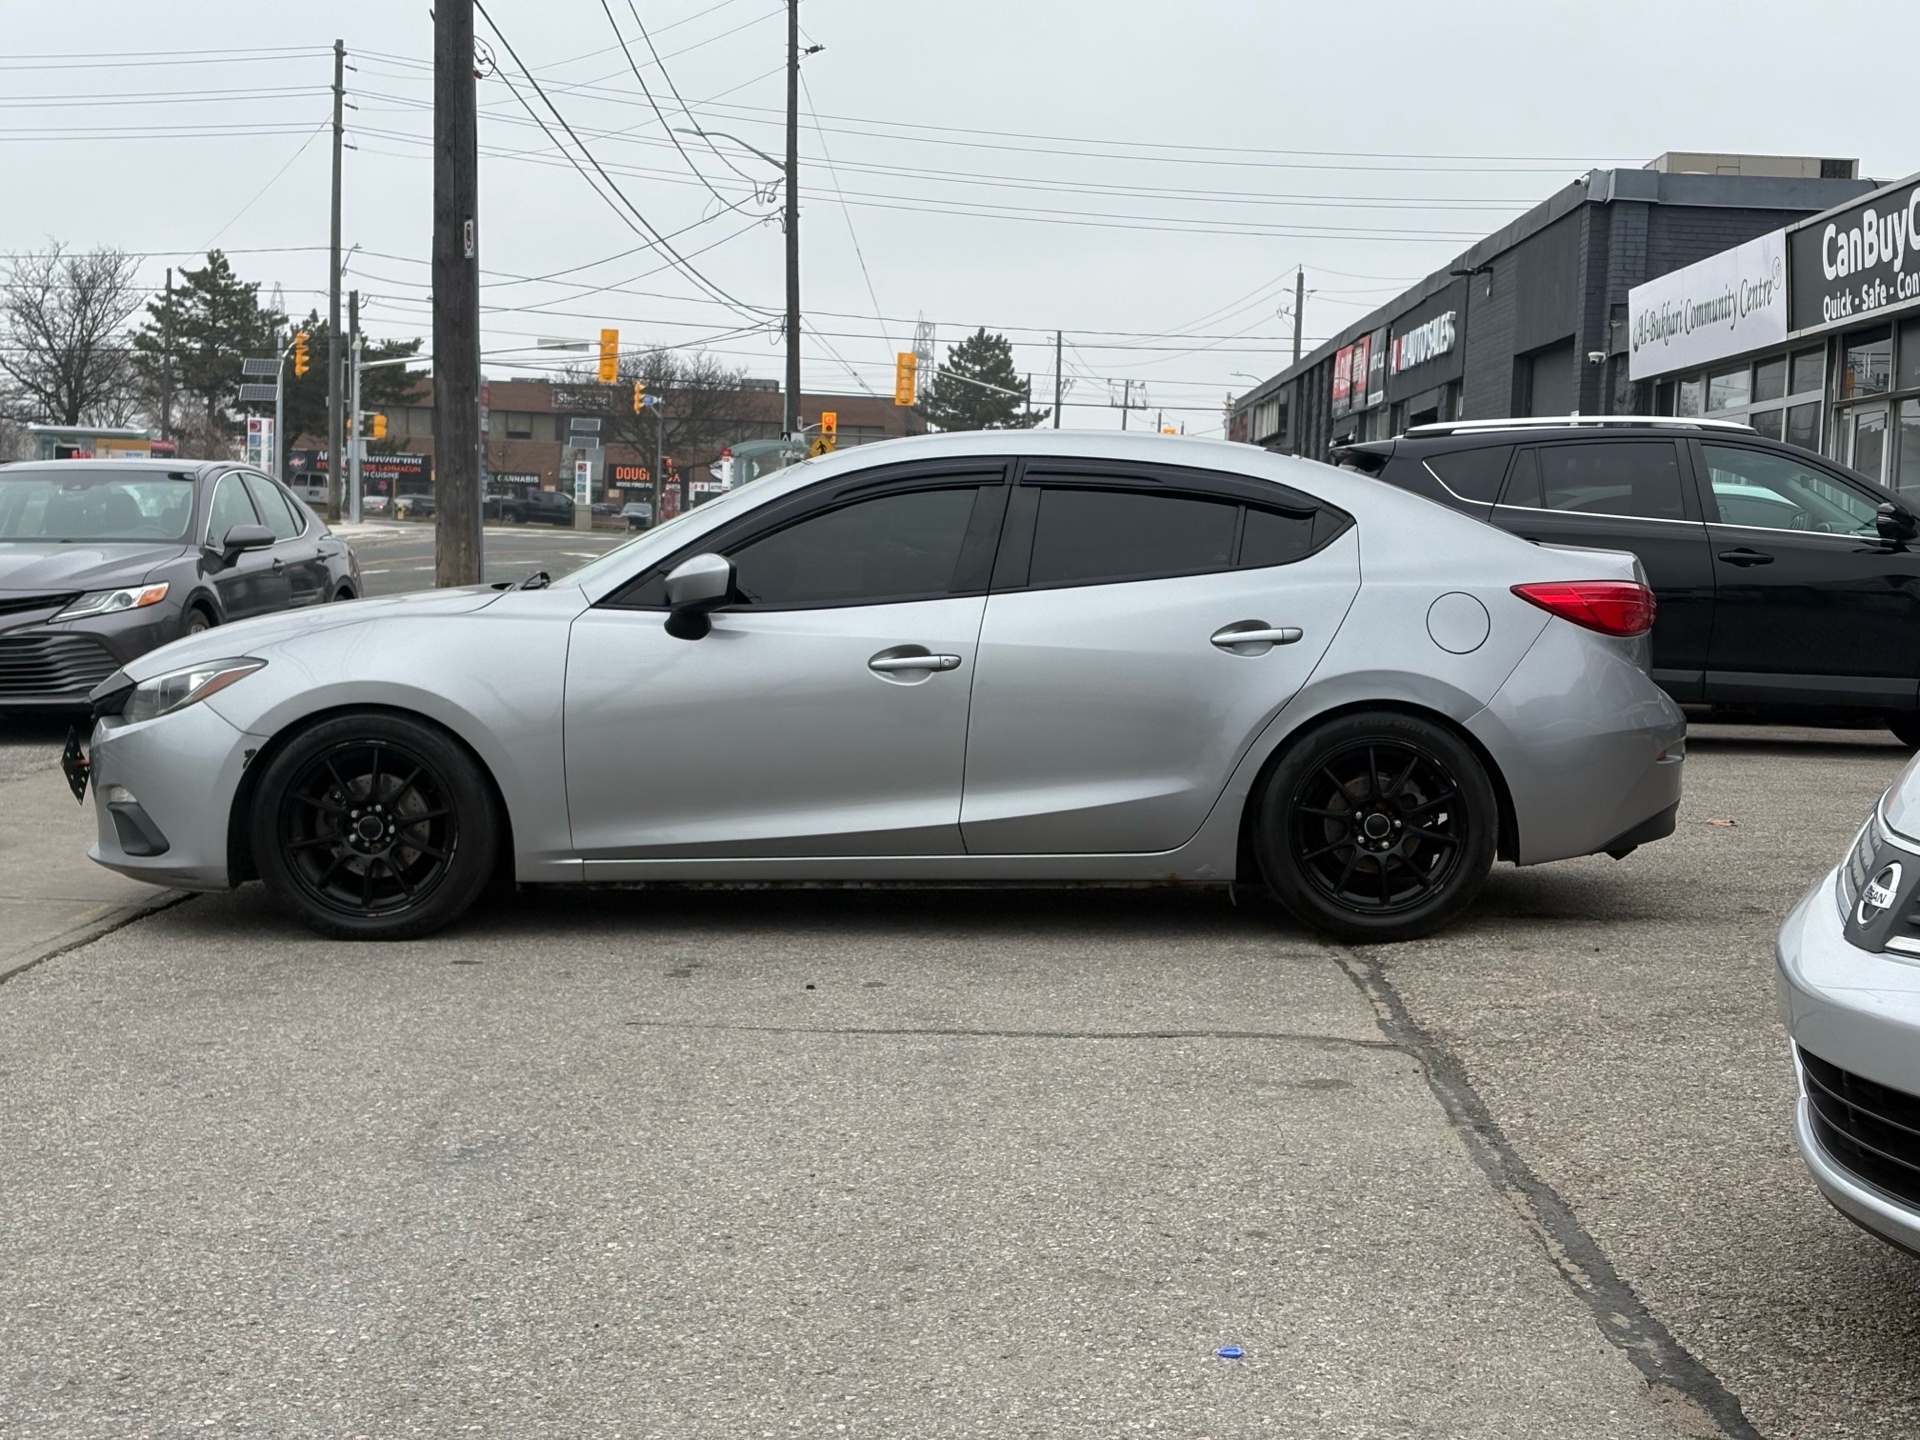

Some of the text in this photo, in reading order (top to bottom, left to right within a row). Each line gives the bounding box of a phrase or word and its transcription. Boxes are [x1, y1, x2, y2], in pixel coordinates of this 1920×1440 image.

[1633, 278, 1773, 353] Al-Bukhari Community Centre
[1823, 288, 1853, 323] Quick
[1862, 278, 1887, 311] Safe
[1897, 271, 1920, 300] Con
[1427, 311, 1456, 359] SALES
[497, 474, 539, 484] CANNABIS
